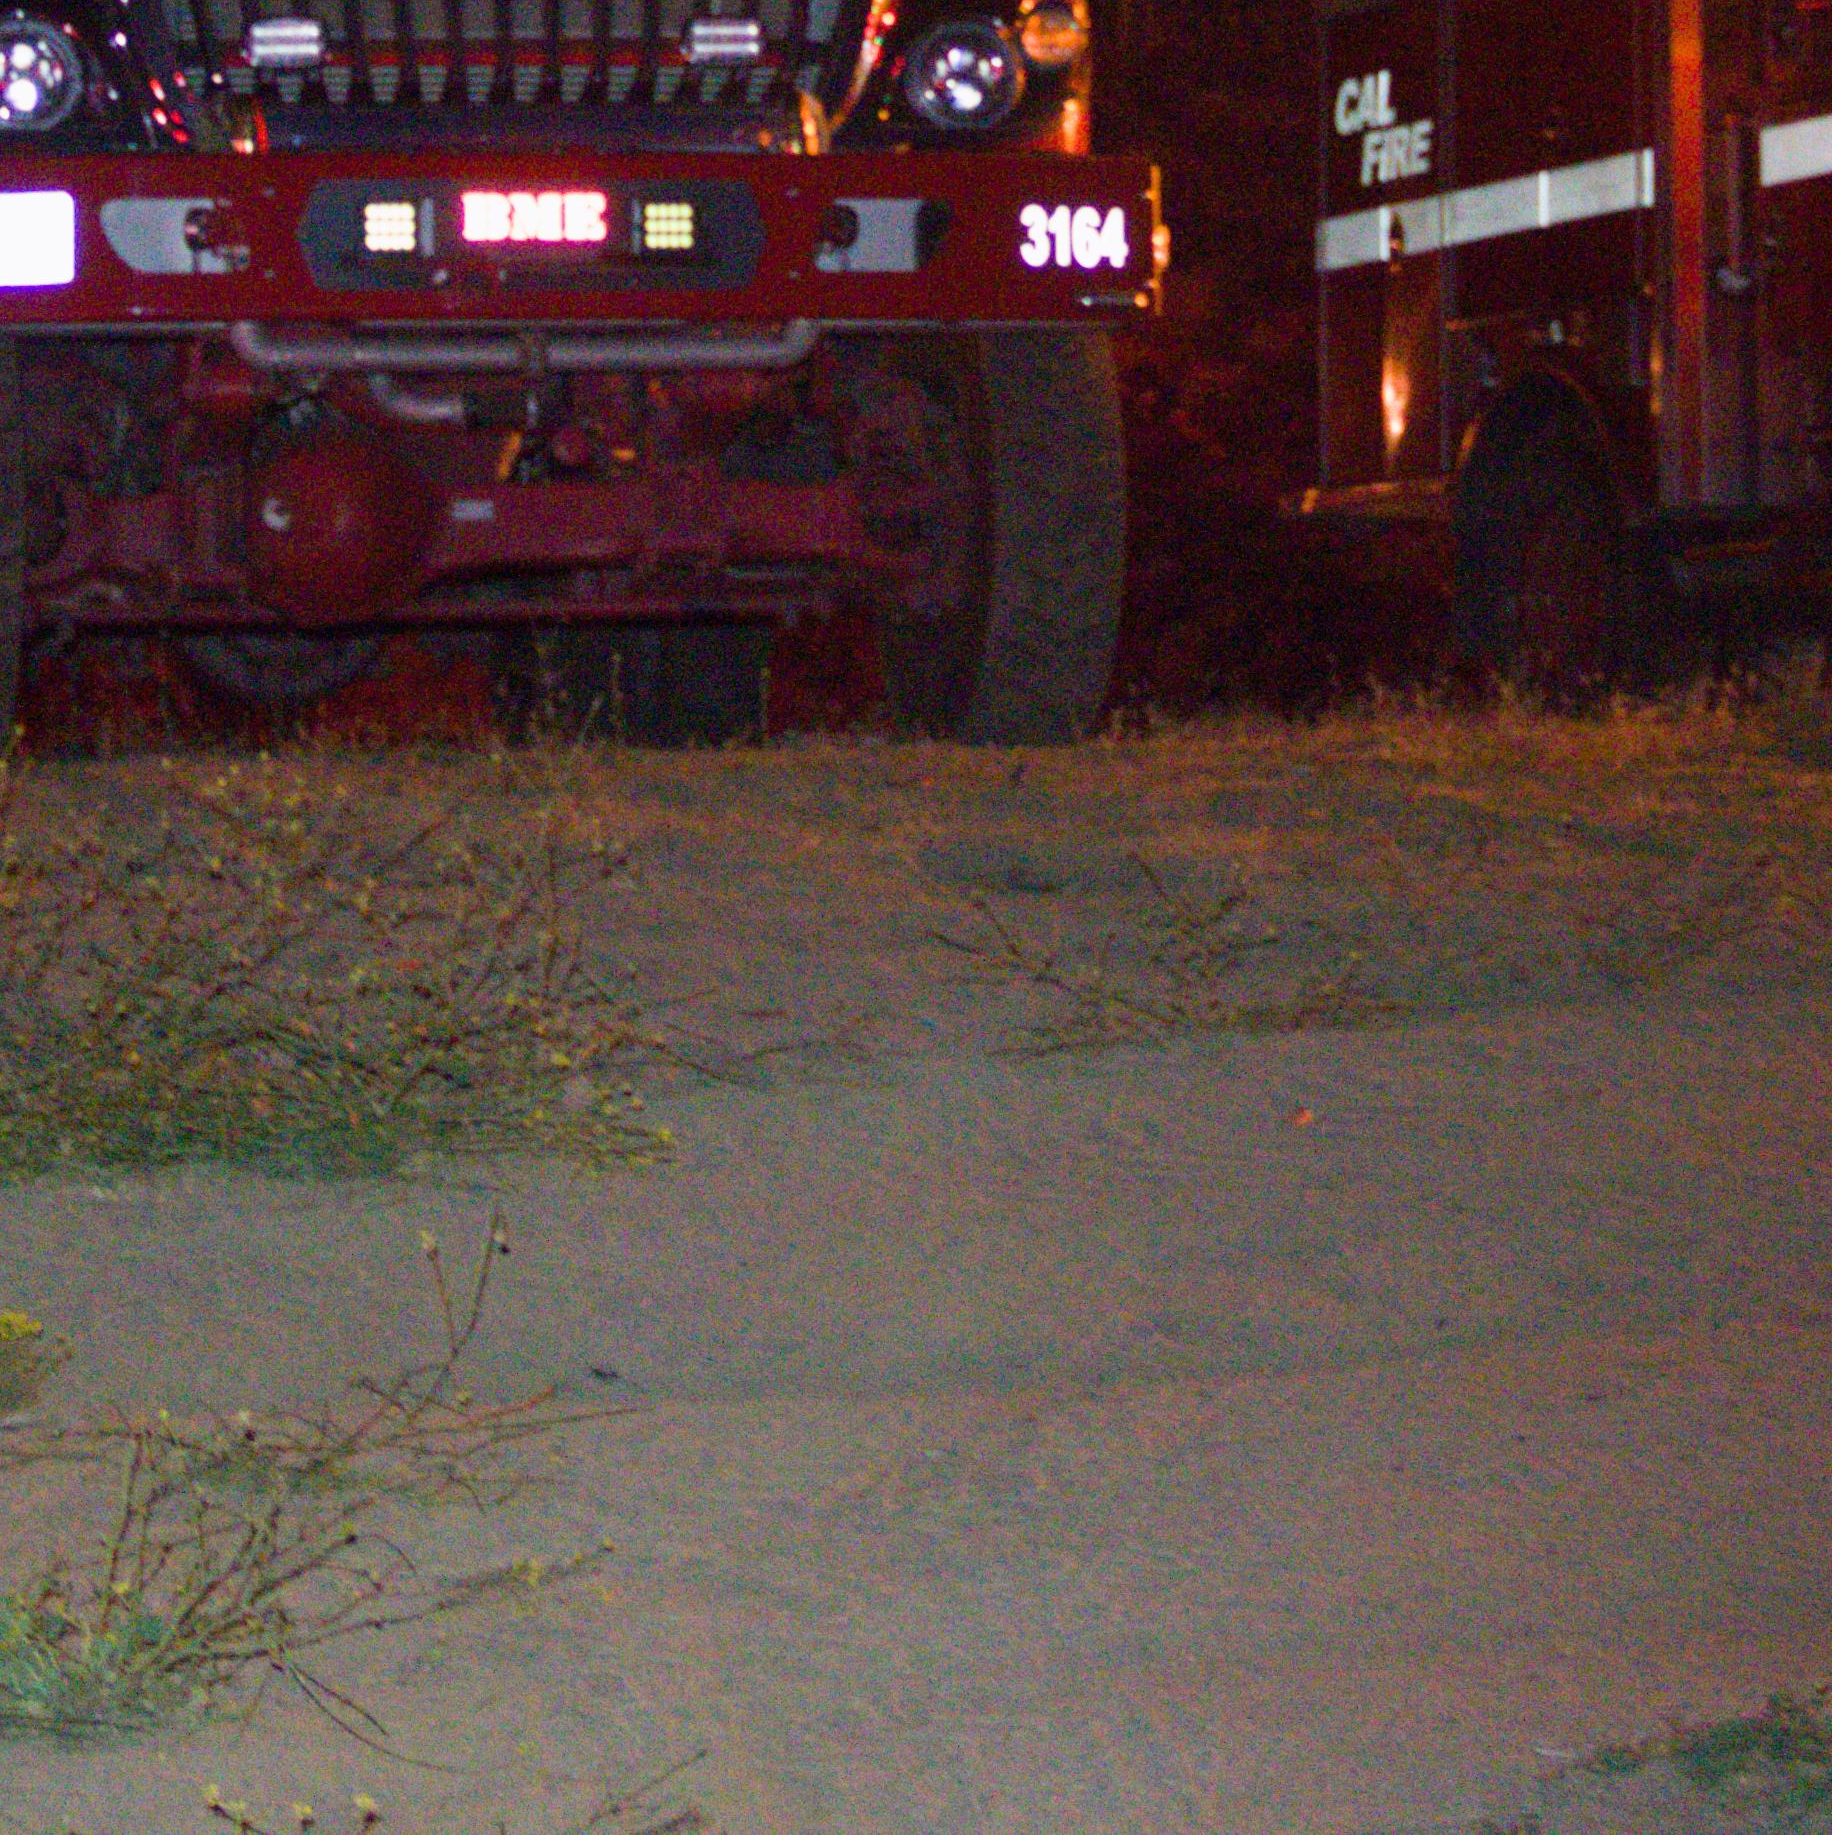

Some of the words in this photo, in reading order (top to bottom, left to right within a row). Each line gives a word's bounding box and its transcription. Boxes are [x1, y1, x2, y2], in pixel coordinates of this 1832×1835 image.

[1334, 69, 1396, 136] CAL
[1360, 119, 1435, 187] FIRE
[461, 191, 608, 242] BME
[1019, 203, 1130, 269] 3164
